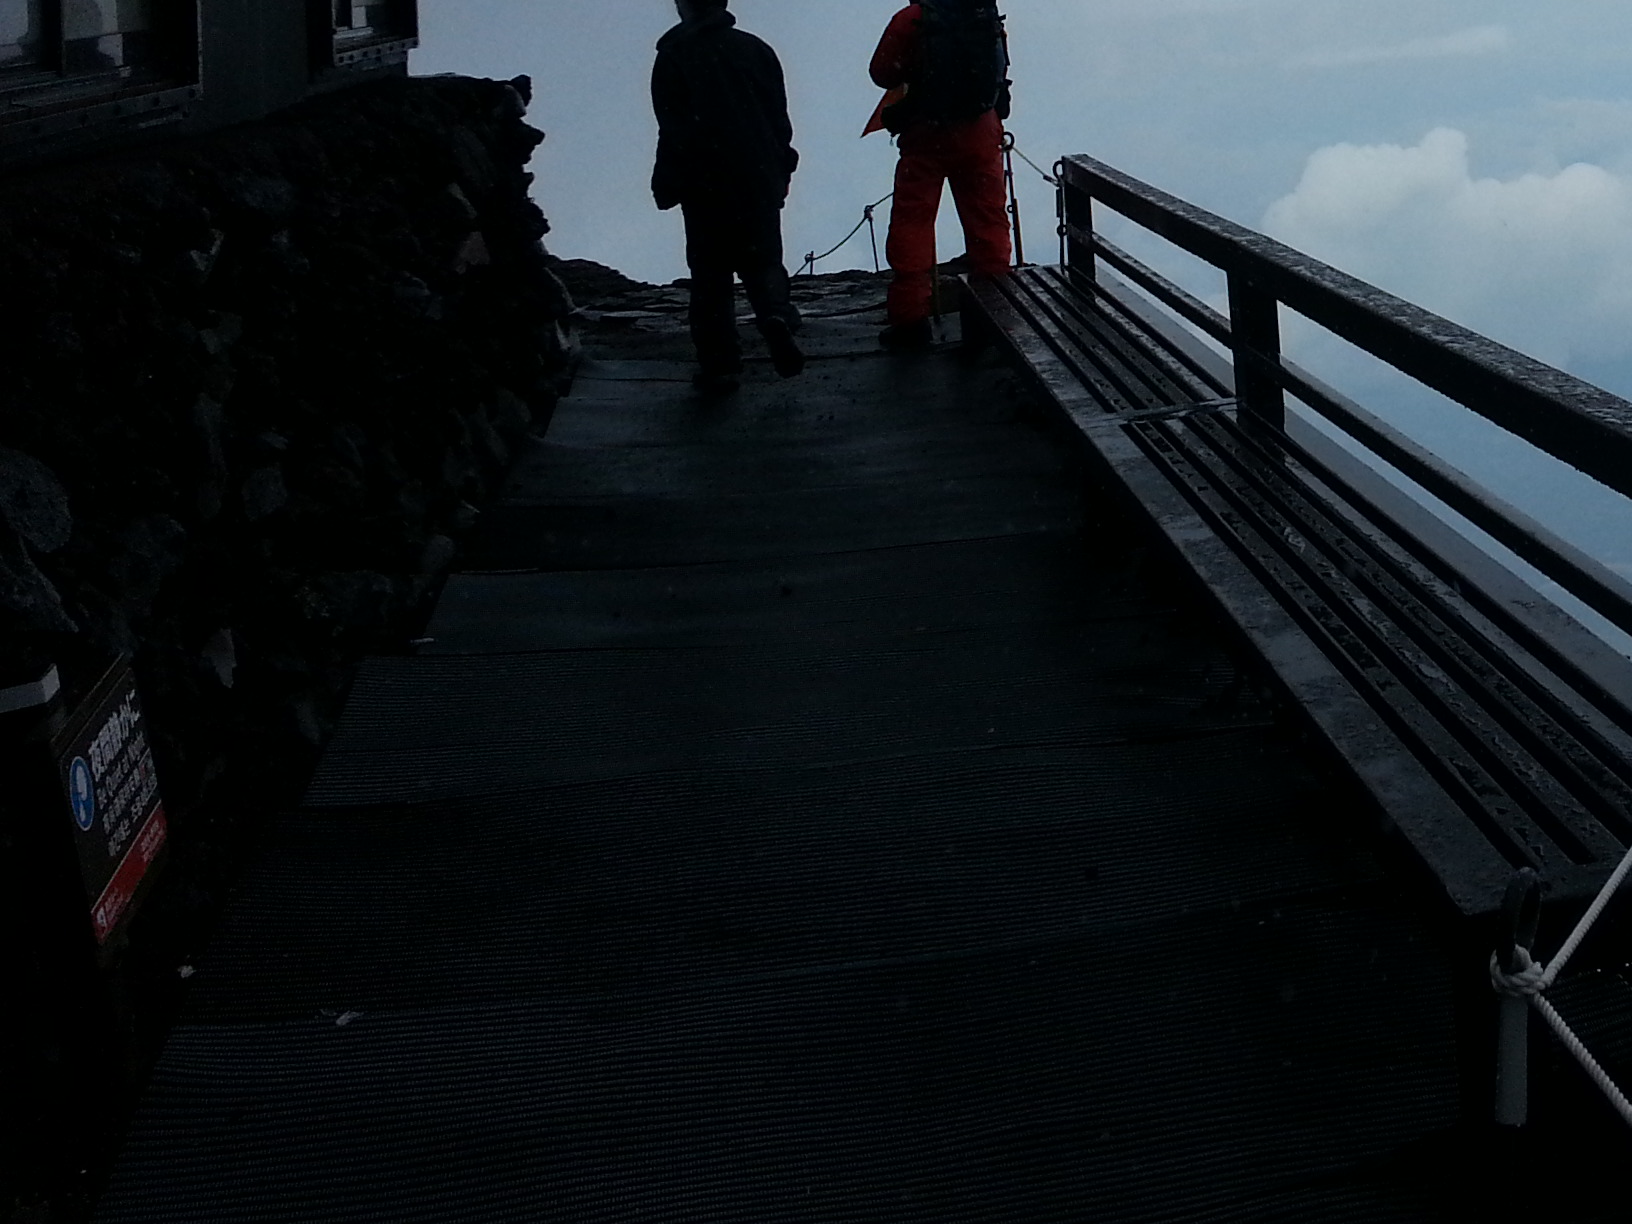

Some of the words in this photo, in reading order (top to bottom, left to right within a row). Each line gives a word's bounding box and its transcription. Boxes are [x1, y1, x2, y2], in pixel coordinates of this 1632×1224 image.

[88, 689, 141, 782] 夜間静かに
